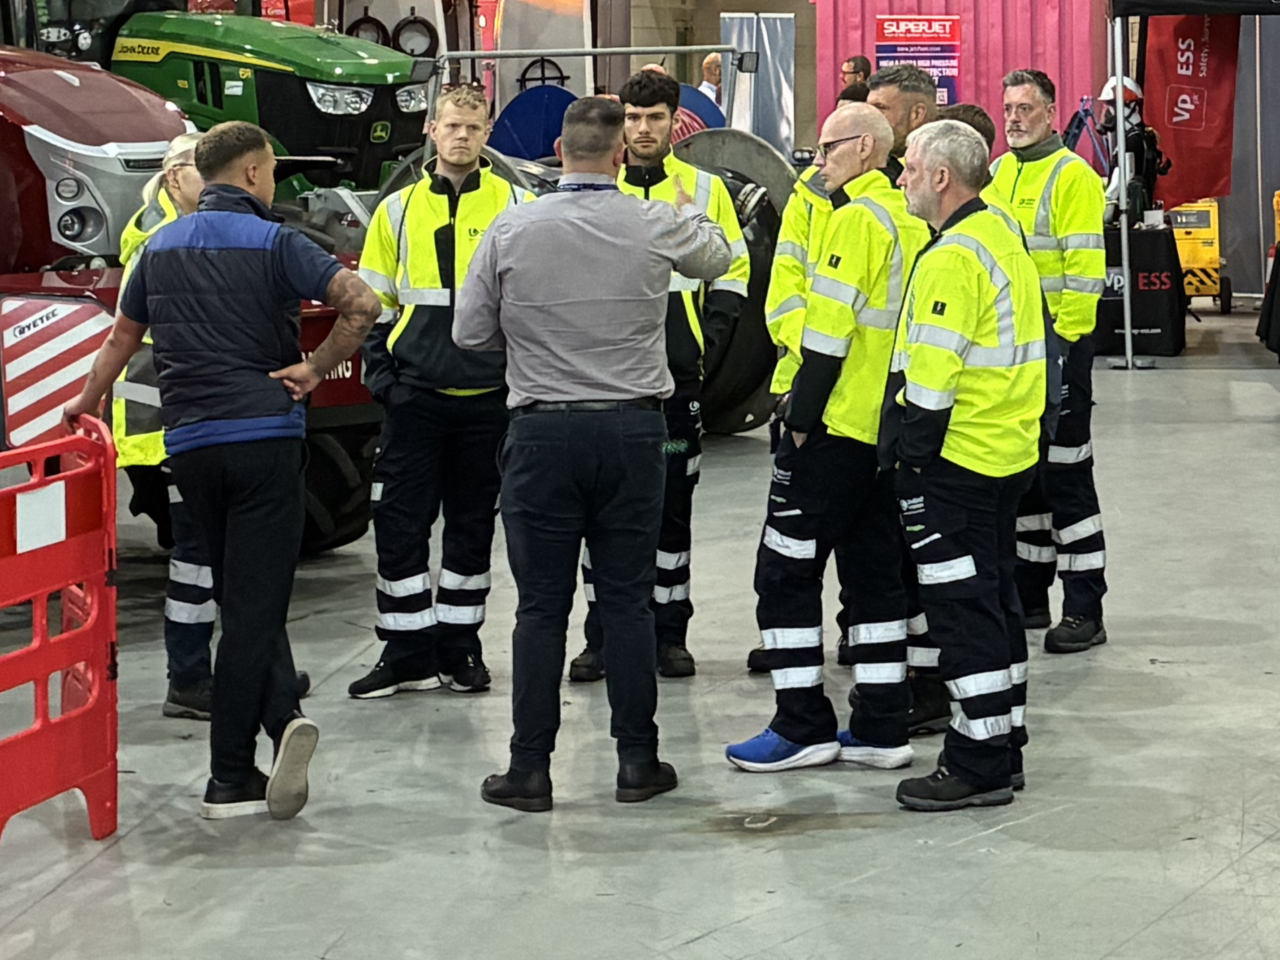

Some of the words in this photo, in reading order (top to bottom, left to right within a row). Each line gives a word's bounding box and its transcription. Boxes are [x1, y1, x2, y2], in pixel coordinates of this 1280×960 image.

[883, 21, 953, 33] SUPERJET
[118, 43, 137, 54] JOHN
[137, 43, 160, 55] DEERE
[1176, 38, 1195, 76] ESS
[1172, 94, 1195, 122] Vp
[1138, 272, 1172, 290] ESS
